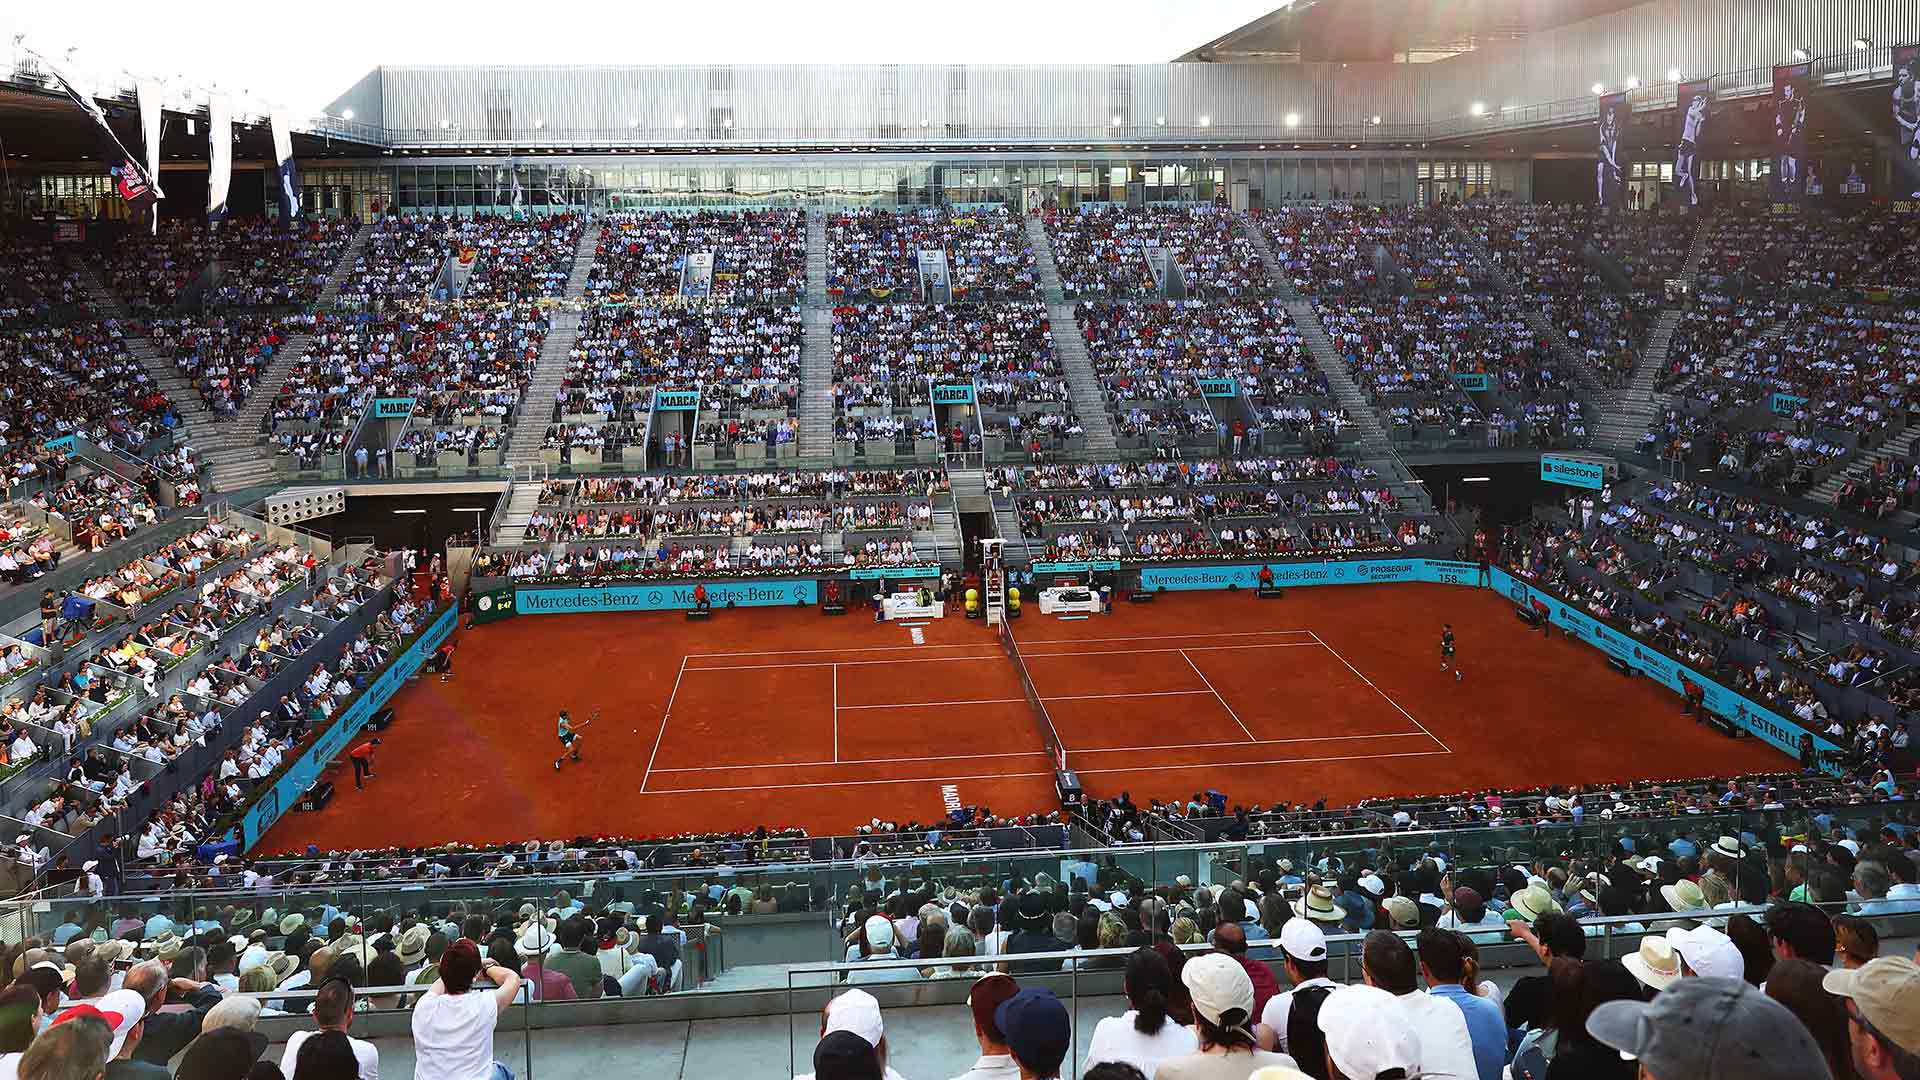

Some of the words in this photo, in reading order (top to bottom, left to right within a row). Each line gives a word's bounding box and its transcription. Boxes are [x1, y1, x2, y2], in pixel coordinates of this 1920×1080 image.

[934, 389, 969, 400] MARCA
[660, 395, 698, 407] MARCA
[1553, 463, 1600, 479] silestone
[1370, 564, 1412, 573] PROSEGUR
[1149, 573, 1227, 585] Mercedes-Benz
[1251, 570, 1327, 582] Mcedes-Benz
[1439, 573, 1458, 584] 158
[526, 592, 640, 609] Mercedes-Benz
[672, 589, 784, 603] Mecedes-Benz
[1751, 713, 1801, 749] ESTRELL
[939, 784, 963, 815] MADRI
